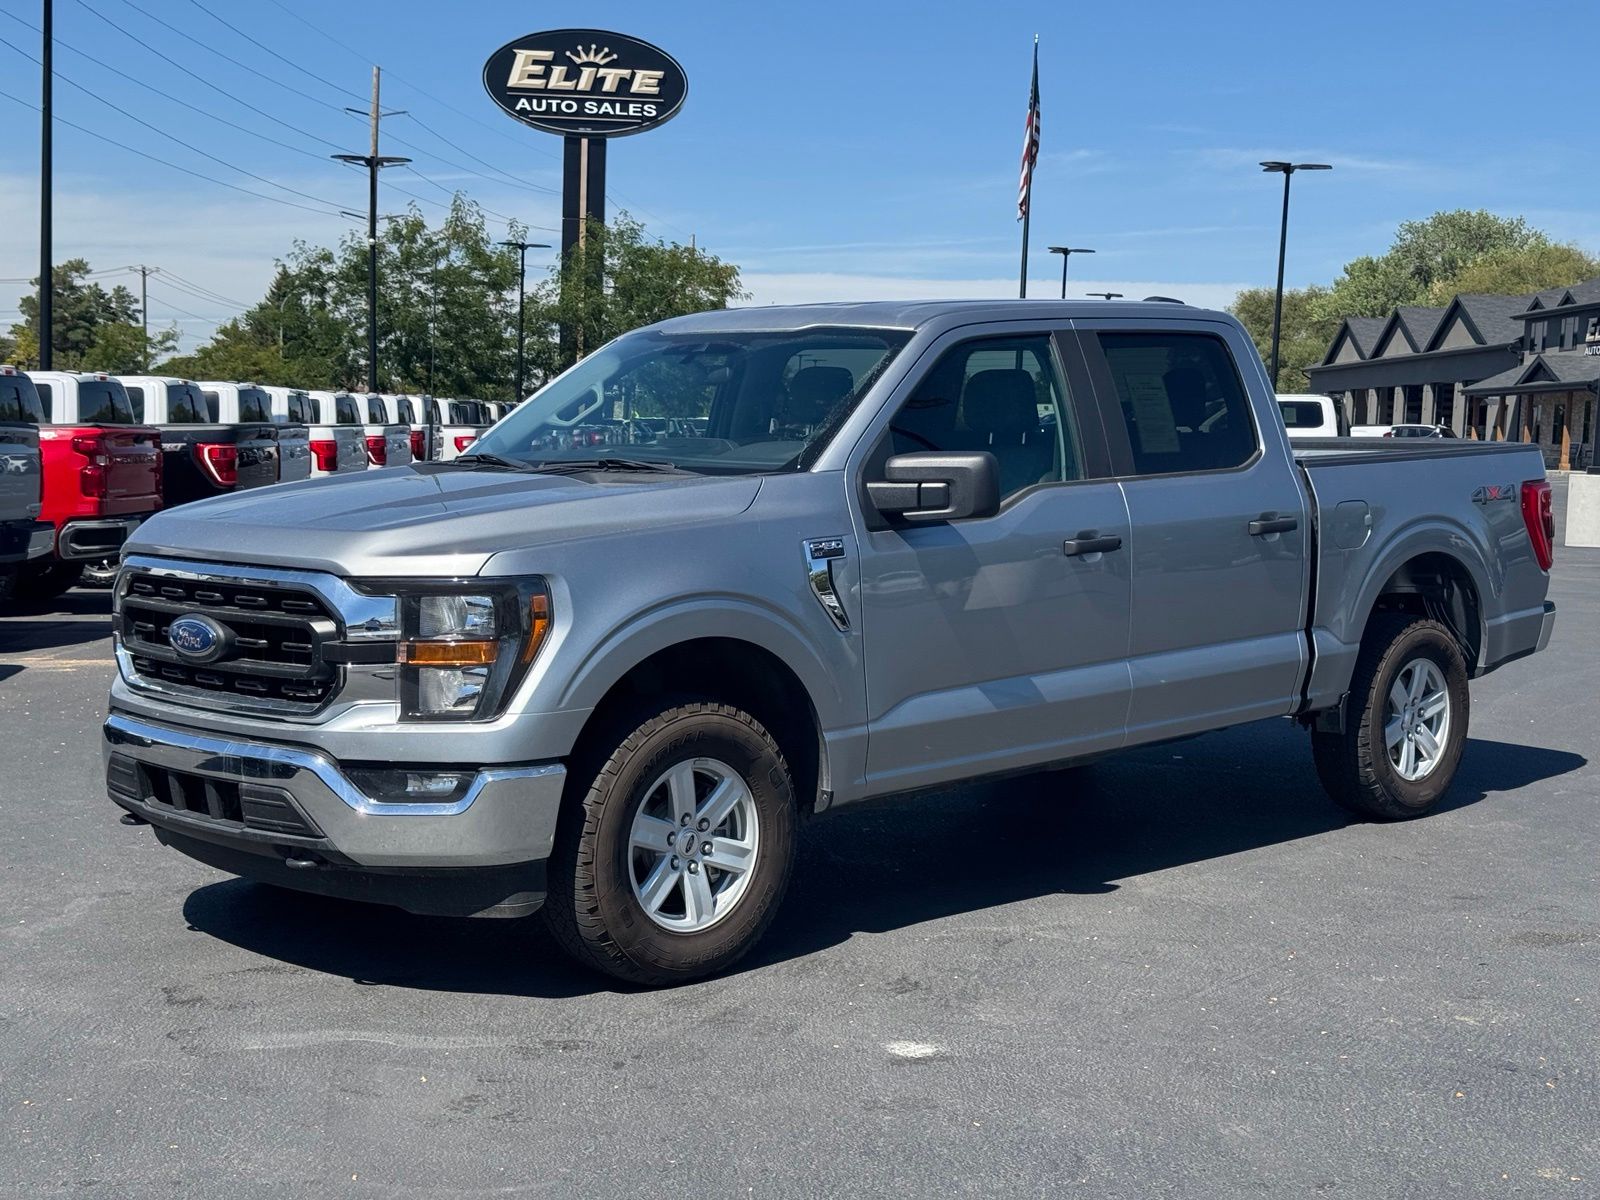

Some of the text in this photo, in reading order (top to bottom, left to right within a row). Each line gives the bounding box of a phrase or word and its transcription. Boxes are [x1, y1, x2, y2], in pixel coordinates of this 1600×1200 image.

[515, 98, 657, 117] AUTO SALES
[177, 626, 204, 648] Ford
